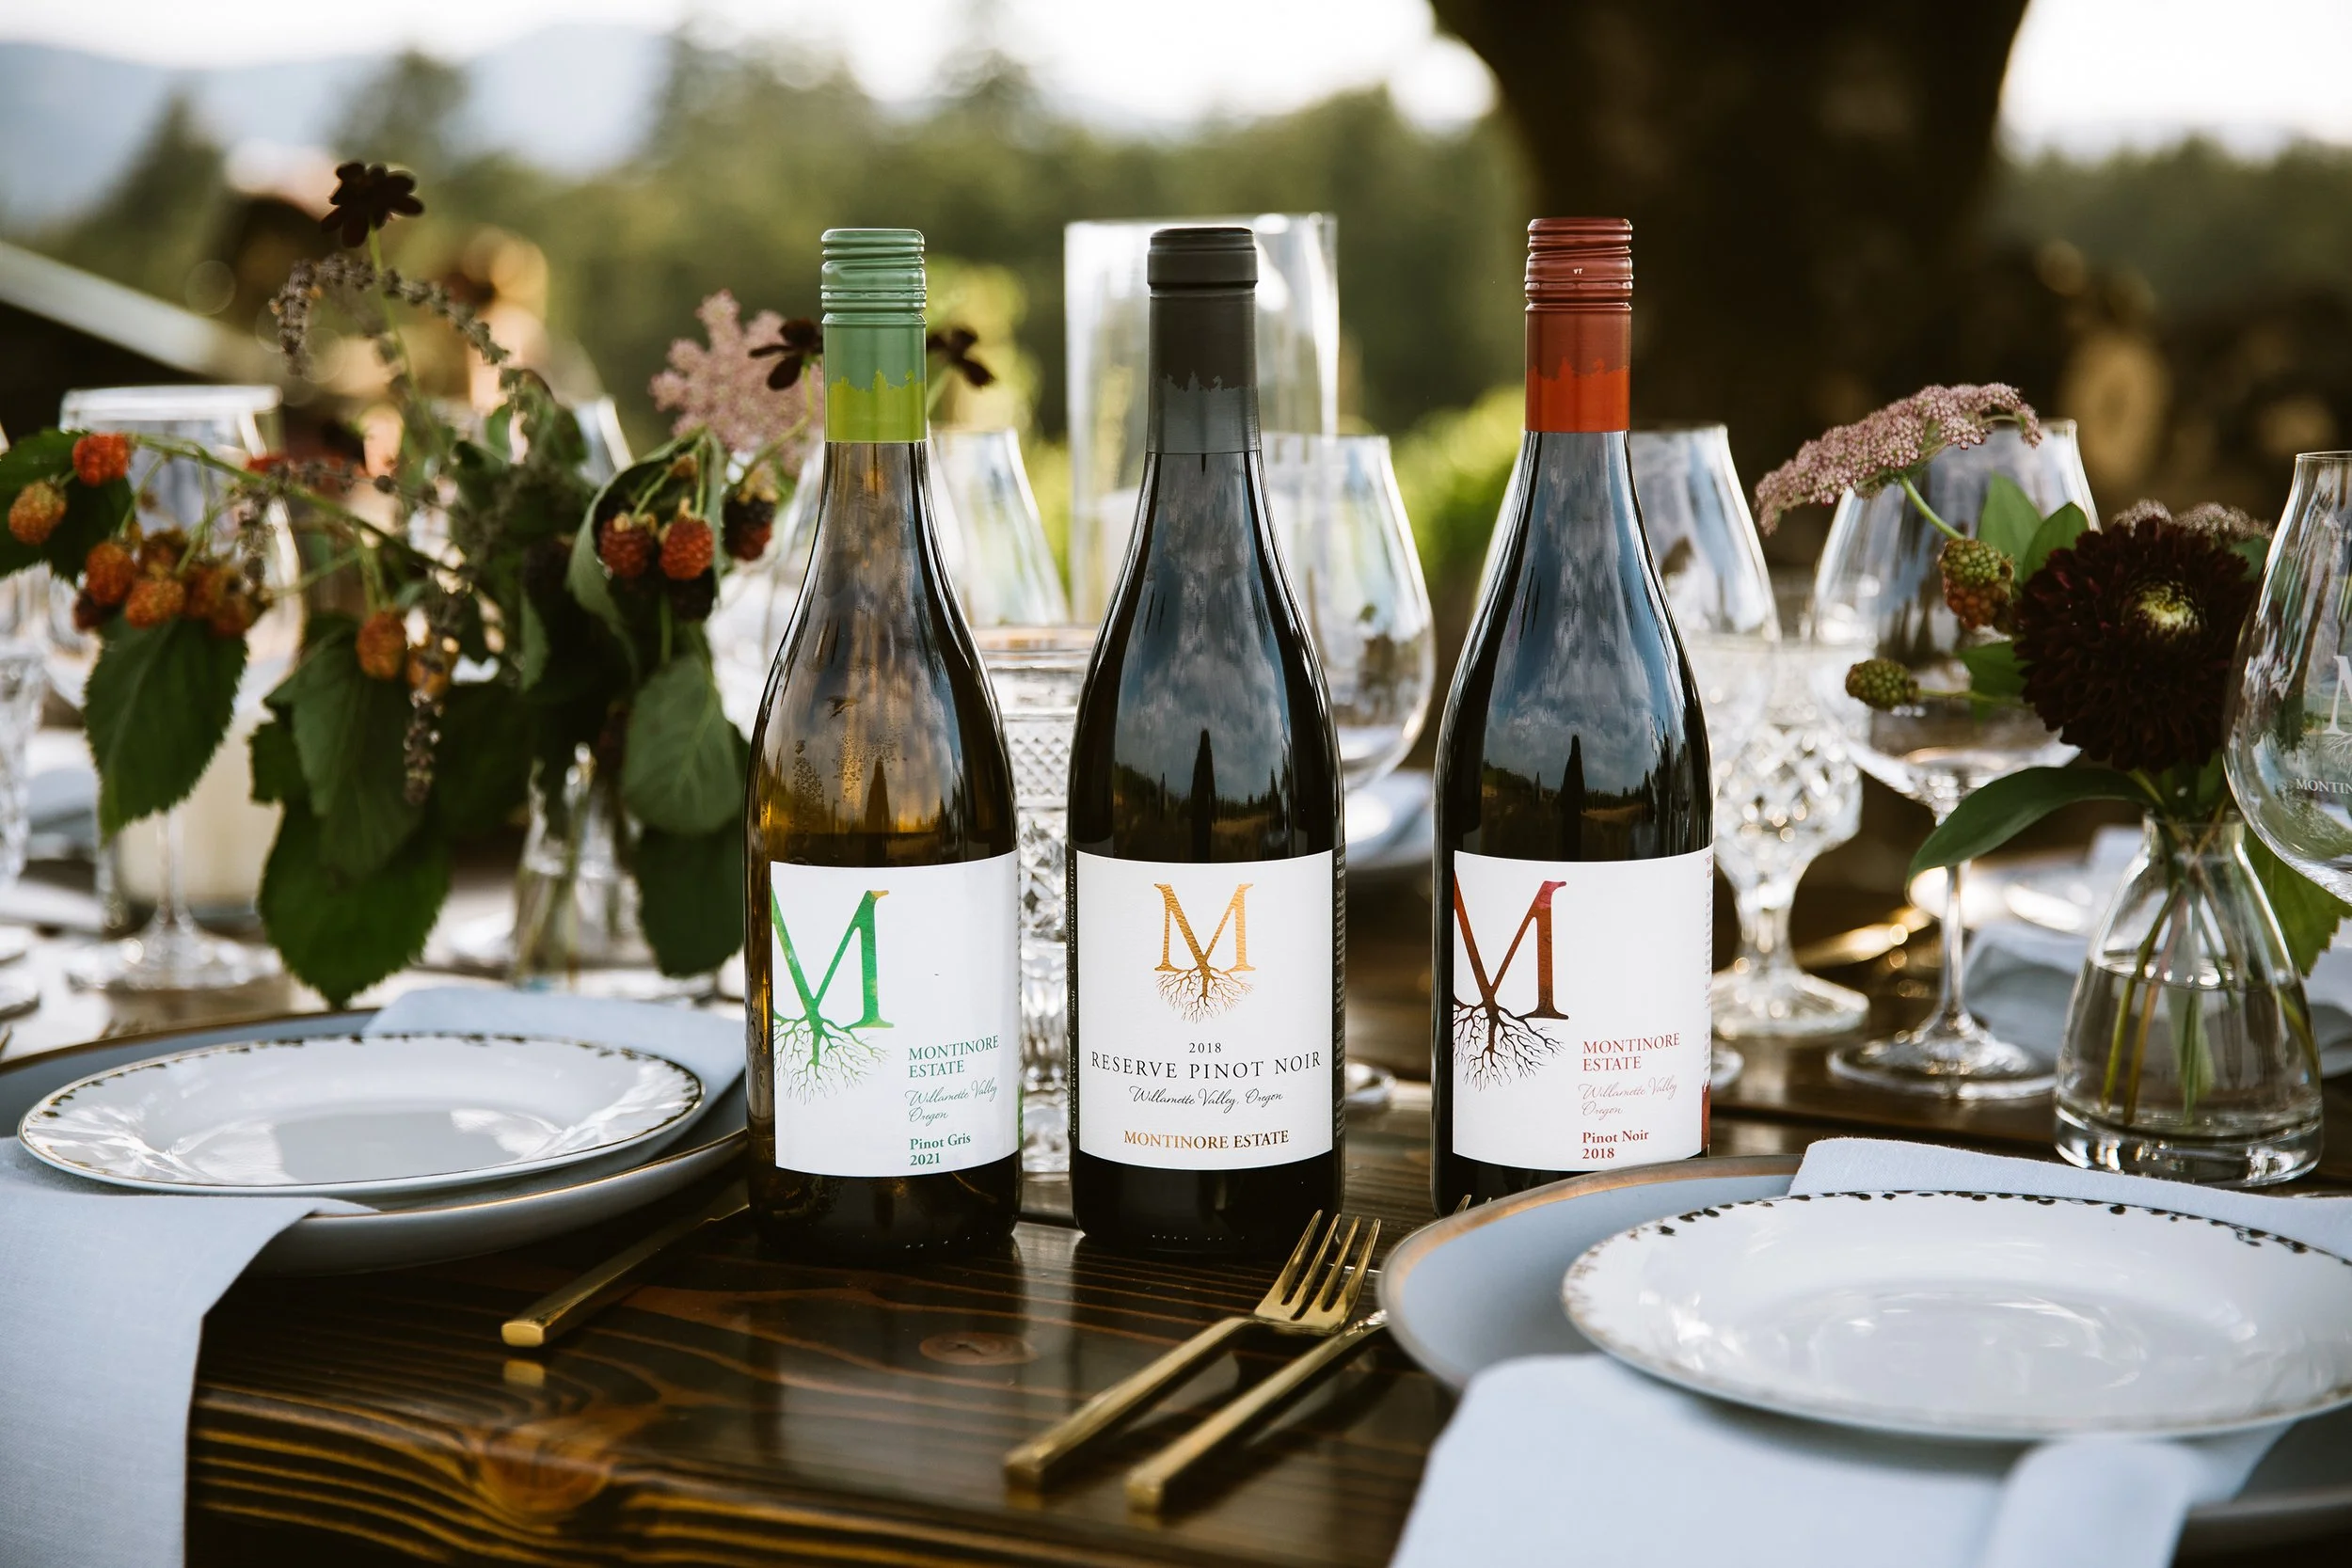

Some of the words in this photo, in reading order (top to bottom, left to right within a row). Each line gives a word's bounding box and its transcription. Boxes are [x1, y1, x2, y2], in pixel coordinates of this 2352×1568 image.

[1154, 883, 1256, 972] M
[909, 1035, 999, 1061] MONTINORE
[1188, 1042, 1222, 1053] 2018
[1582, 1033, 1680, 1054] MONTINORE
[909, 1060, 965, 1078] ESTATE
[1091, 1051, 1177, 1079] RESERVE
[1190, 1061, 1263, 1079] PINOT
[1274, 1051, 1321, 1075] NOIR
[1582, 1056, 1642, 1071] ESTATE
[905, 1088, 969, 1106] Willamette
[971, 1077, 997, 1101] Valley
[1578, 1082, 1645, 1100] Willamette
[1648, 1075, 1677, 1100] Valley
[1129, 1085, 1195, 1106] Willamette
[1199, 1088, 1239, 1113] Valley,
[1246, 1087, 1283, 1108] Oregon
[909, 1107, 948, 1126] Oregon
[1581, 1101, 1623, 1120] Oregon
[910, 1137, 945, 1150] Pinot
[947, 1132, 971, 1147] Gris
[1124, 1131, 1229, 1149] MONTINORE
[1233, 1131, 1289, 1148] ESTATE
[1582, 1132, 1617, 1145] Pinot
[1622, 1129, 1649, 1143] Noir
[910, 1153, 941, 1166] 2021
[1582, 1147, 1614, 1160] 2018
